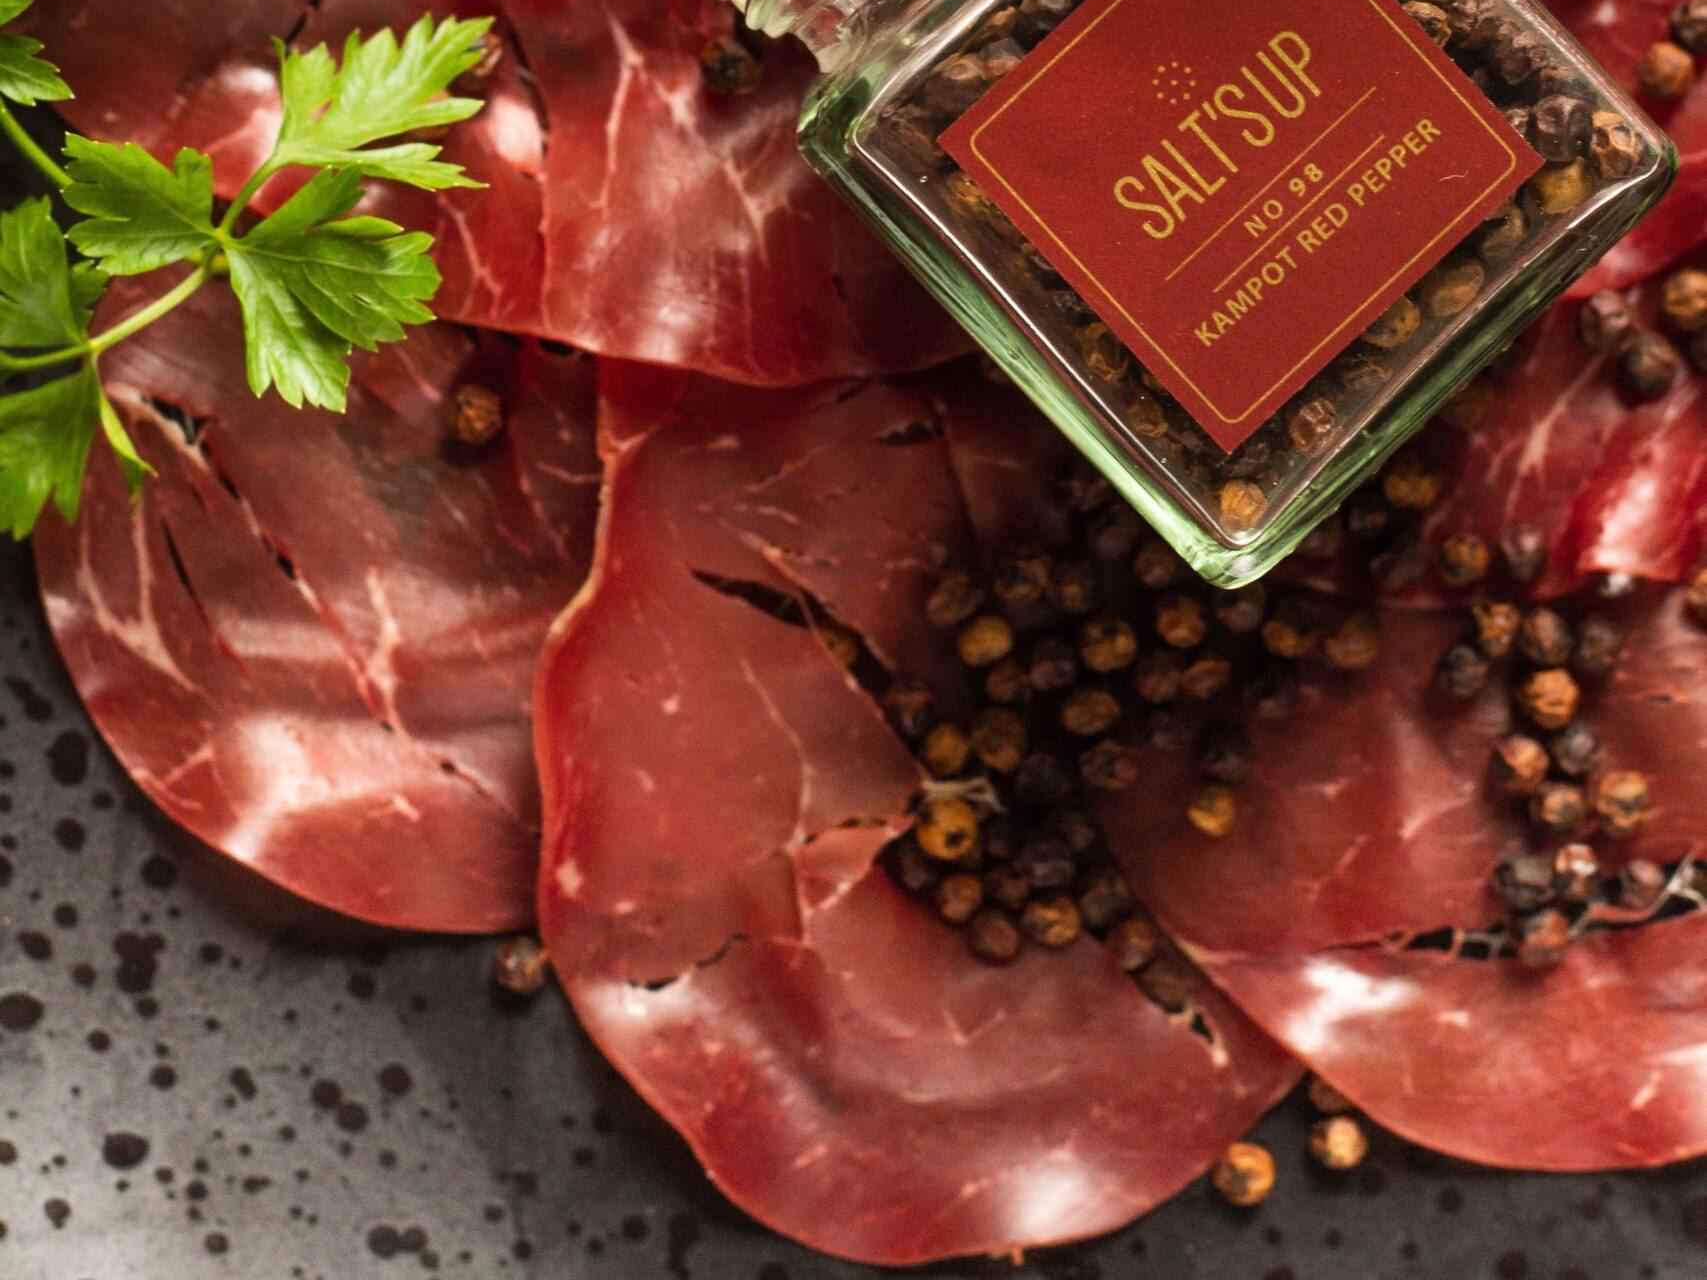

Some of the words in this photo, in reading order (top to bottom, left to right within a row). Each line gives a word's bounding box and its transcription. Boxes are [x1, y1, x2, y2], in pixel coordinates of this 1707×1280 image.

[1194, 245, 1298, 347] KAMPOT
[1296, 203, 1348, 253] RED
[1347, 119, 1442, 206] PEPPER
[1243, 199, 1284, 238] NO
[1289, 163, 1324, 197] 98
